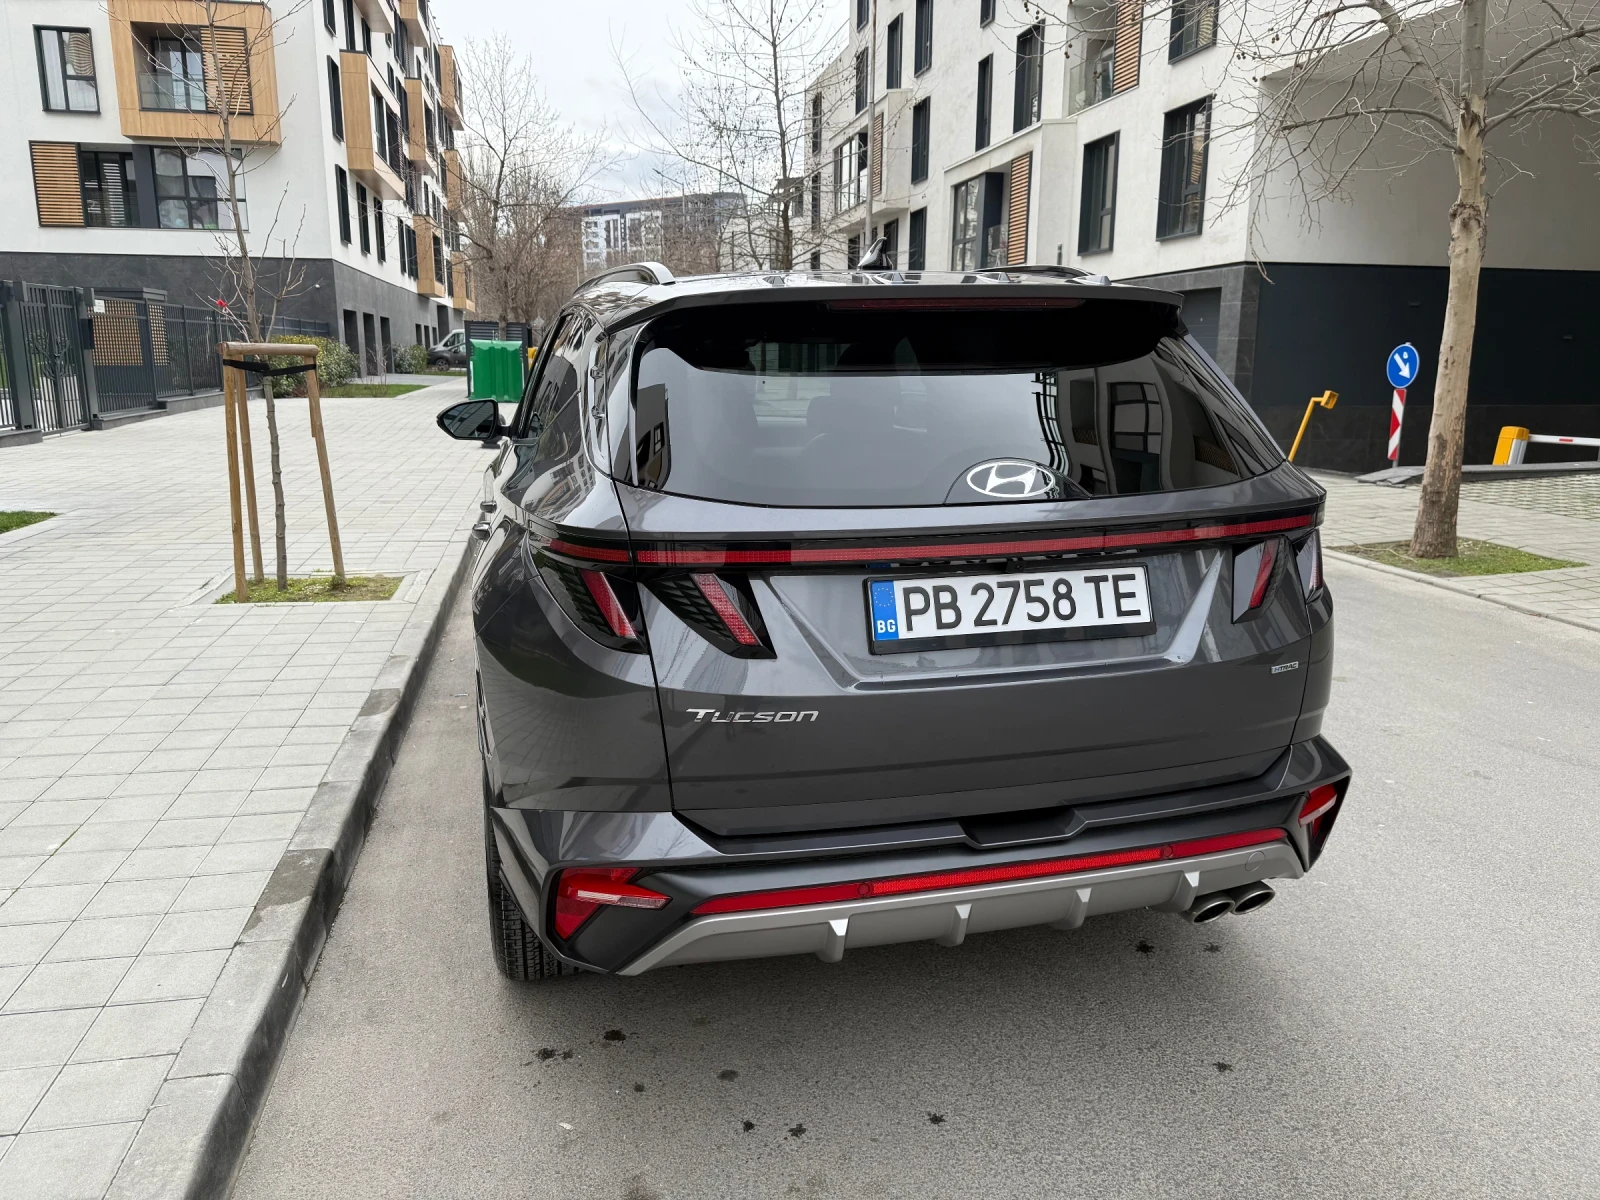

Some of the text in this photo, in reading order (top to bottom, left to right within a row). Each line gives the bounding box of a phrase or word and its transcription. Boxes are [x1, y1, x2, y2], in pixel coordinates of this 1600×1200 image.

[903, 574, 1142, 631] PB 2758 TE
[877, 619, 896, 633] BG
